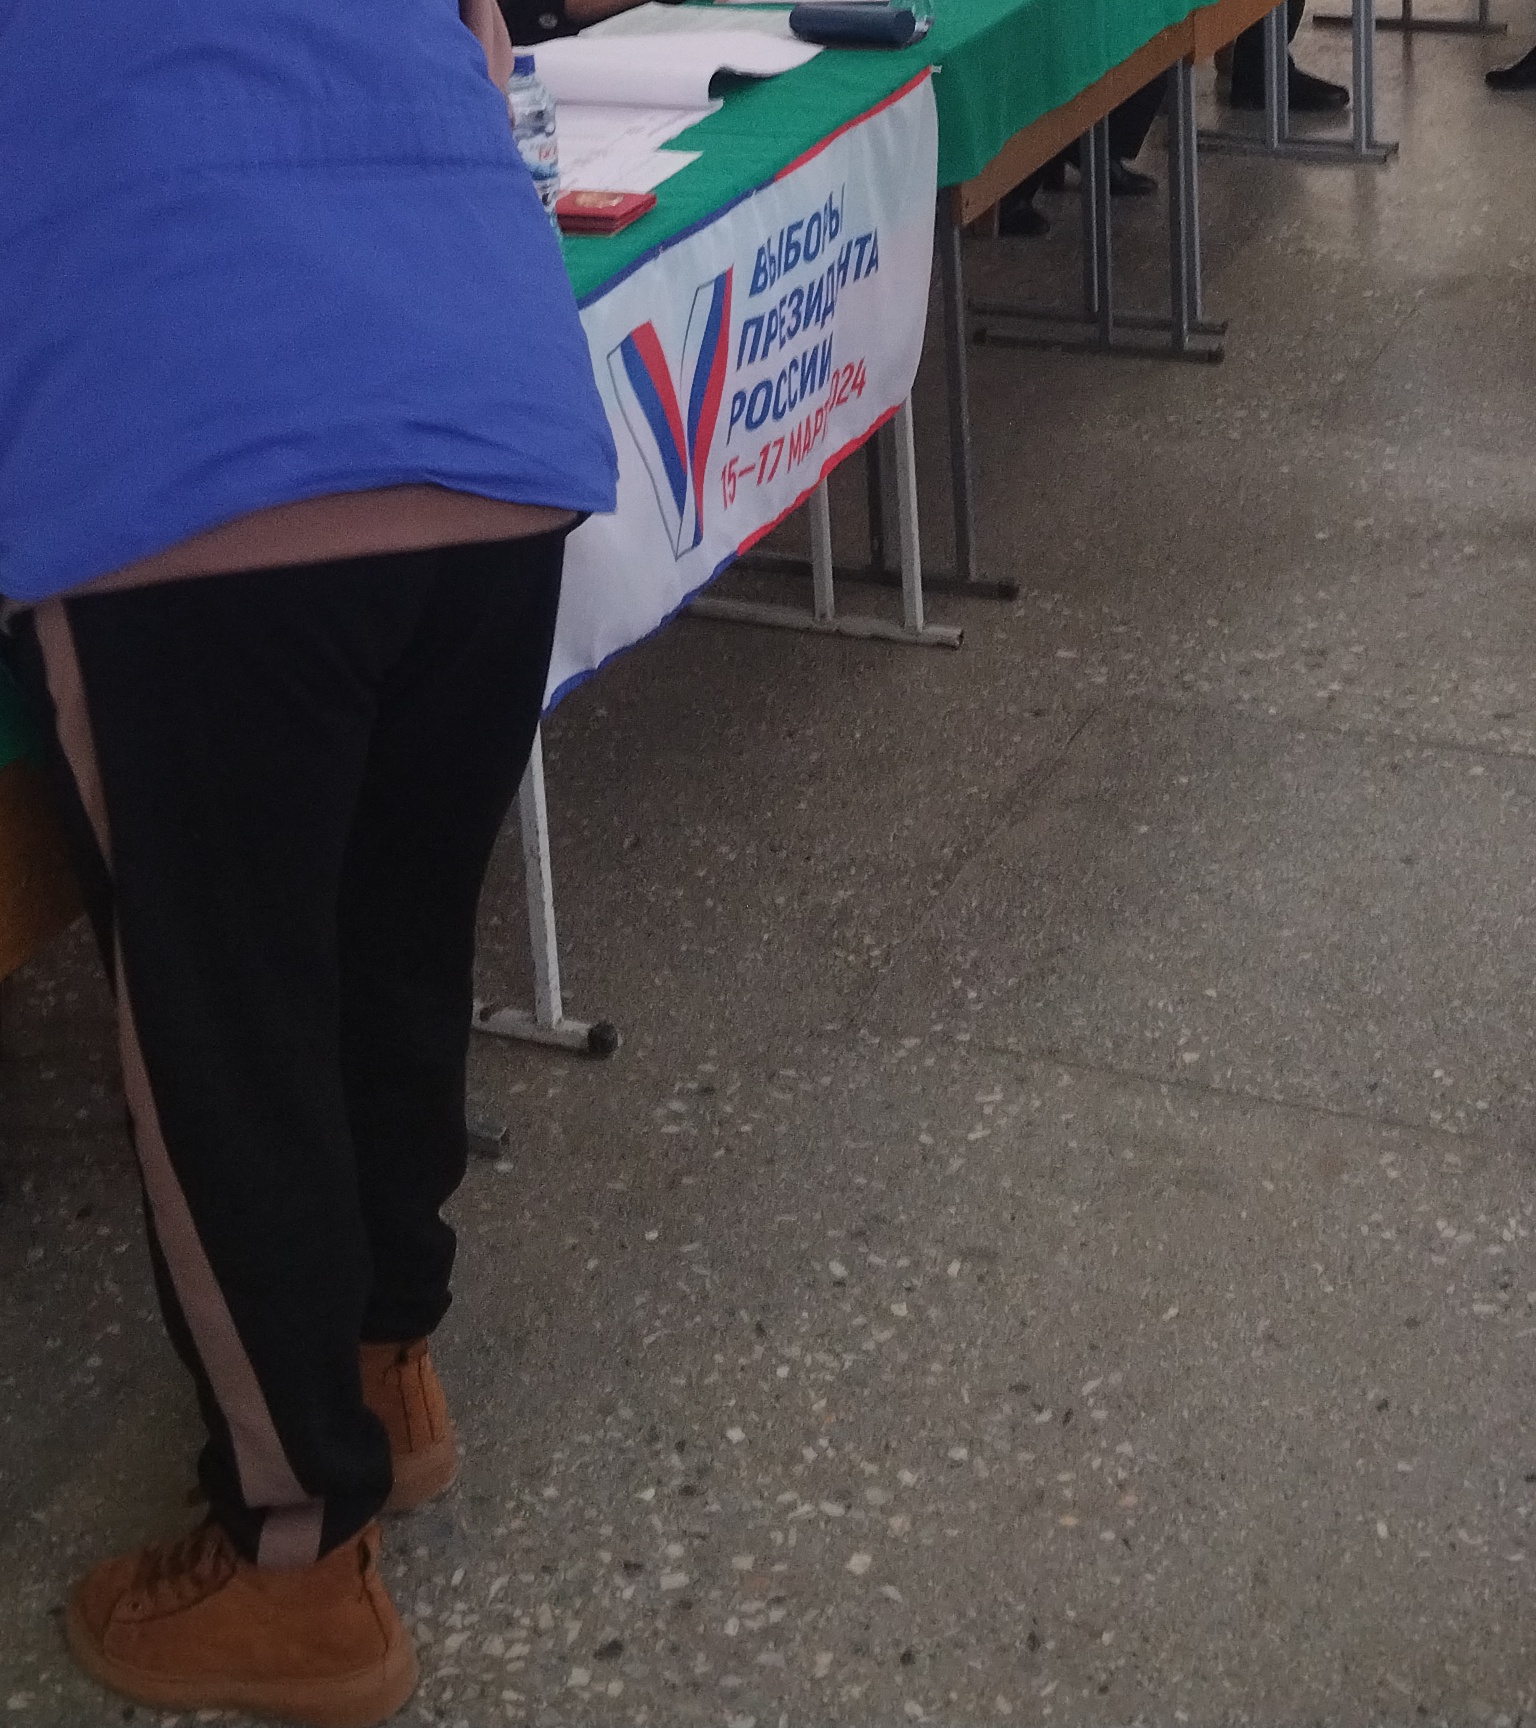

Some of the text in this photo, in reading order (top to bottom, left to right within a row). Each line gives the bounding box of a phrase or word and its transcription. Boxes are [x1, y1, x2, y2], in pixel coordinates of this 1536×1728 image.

[736, 226, 880, 372] ПРЕЗИДНТА
[748, 181, 846, 299] ВЫБОРЫ
[726, 330, 834, 447] РОССИИ
